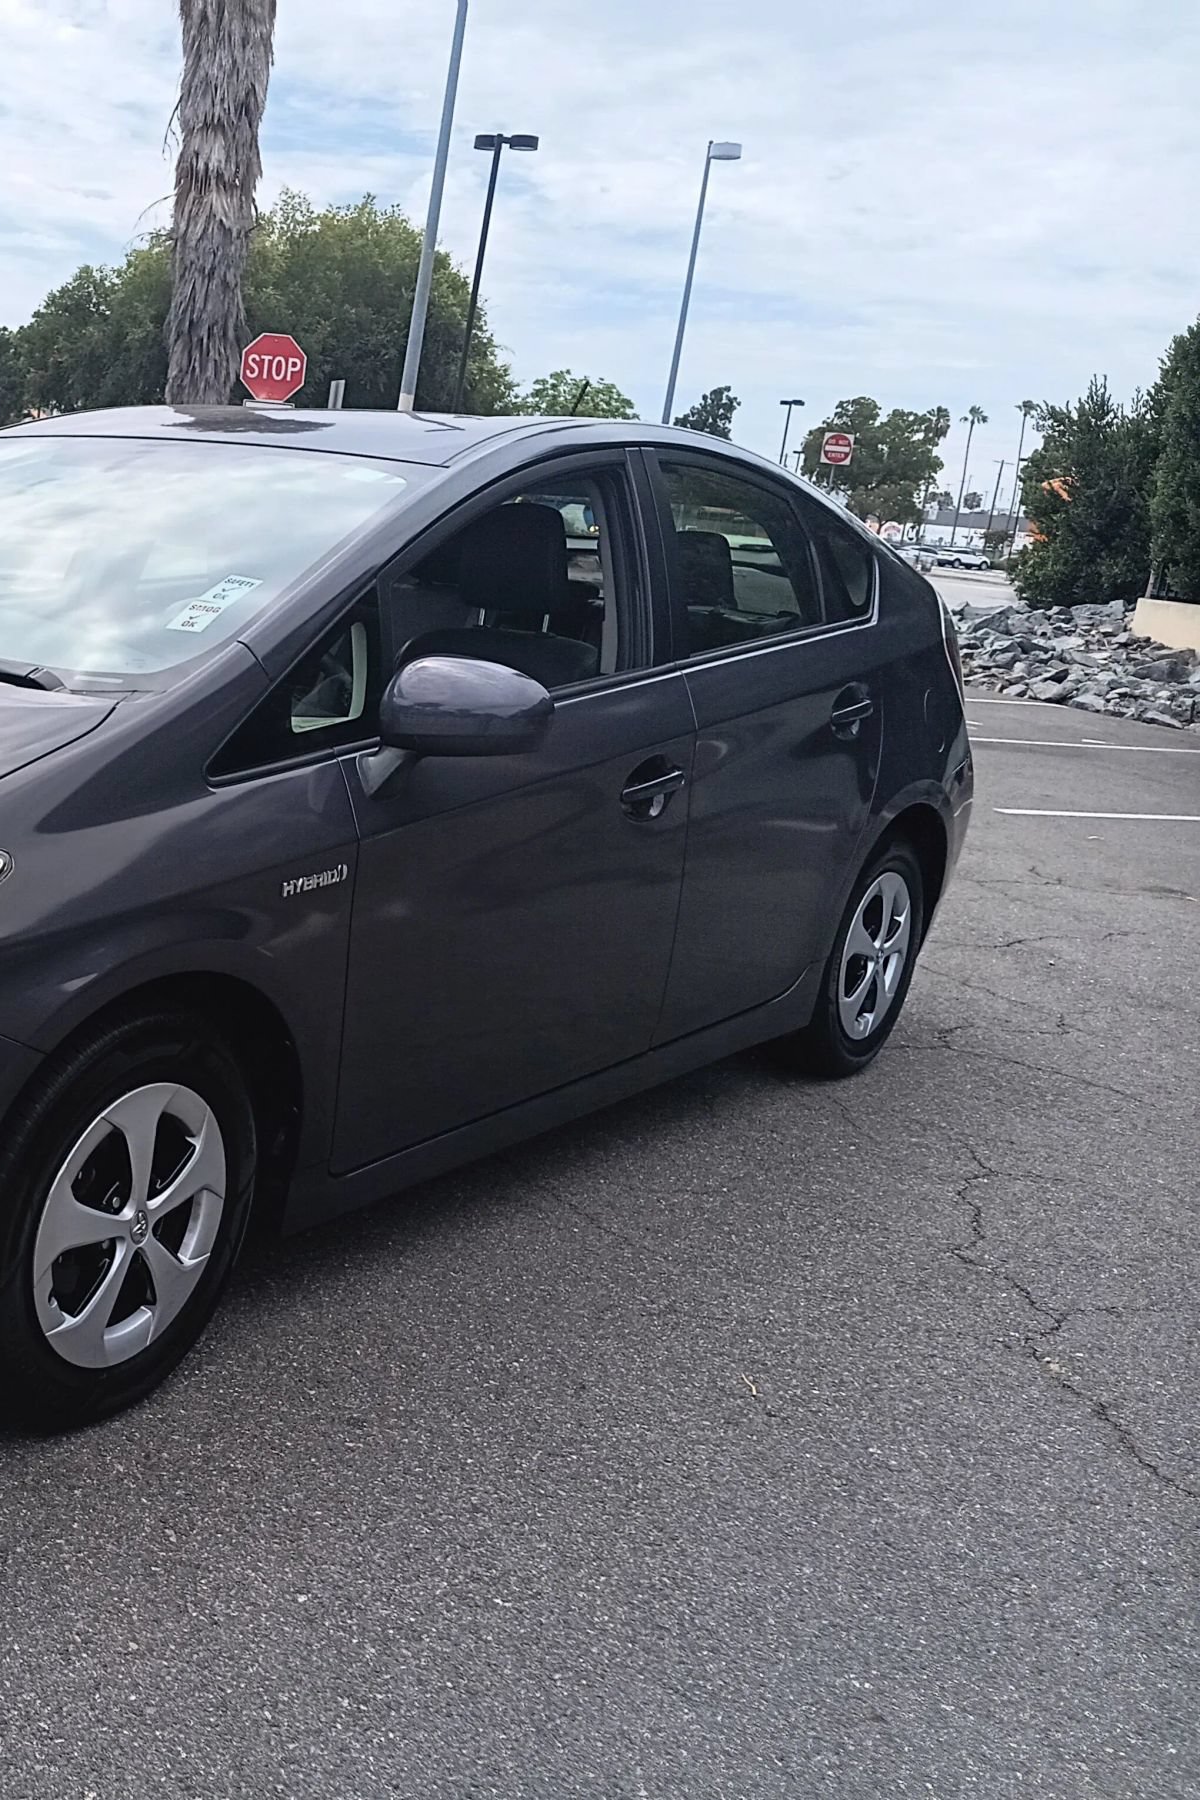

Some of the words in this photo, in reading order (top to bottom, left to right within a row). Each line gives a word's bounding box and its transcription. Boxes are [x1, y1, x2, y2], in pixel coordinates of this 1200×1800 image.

[245, 353, 301, 382] STOP
[224, 577, 256, 588] SAFETY
[212, 593, 230, 601] OK
[189, 604, 222, 614] SMOG
[181, 620, 198, 628] OK
[282, 866, 344, 898] HYBRID
